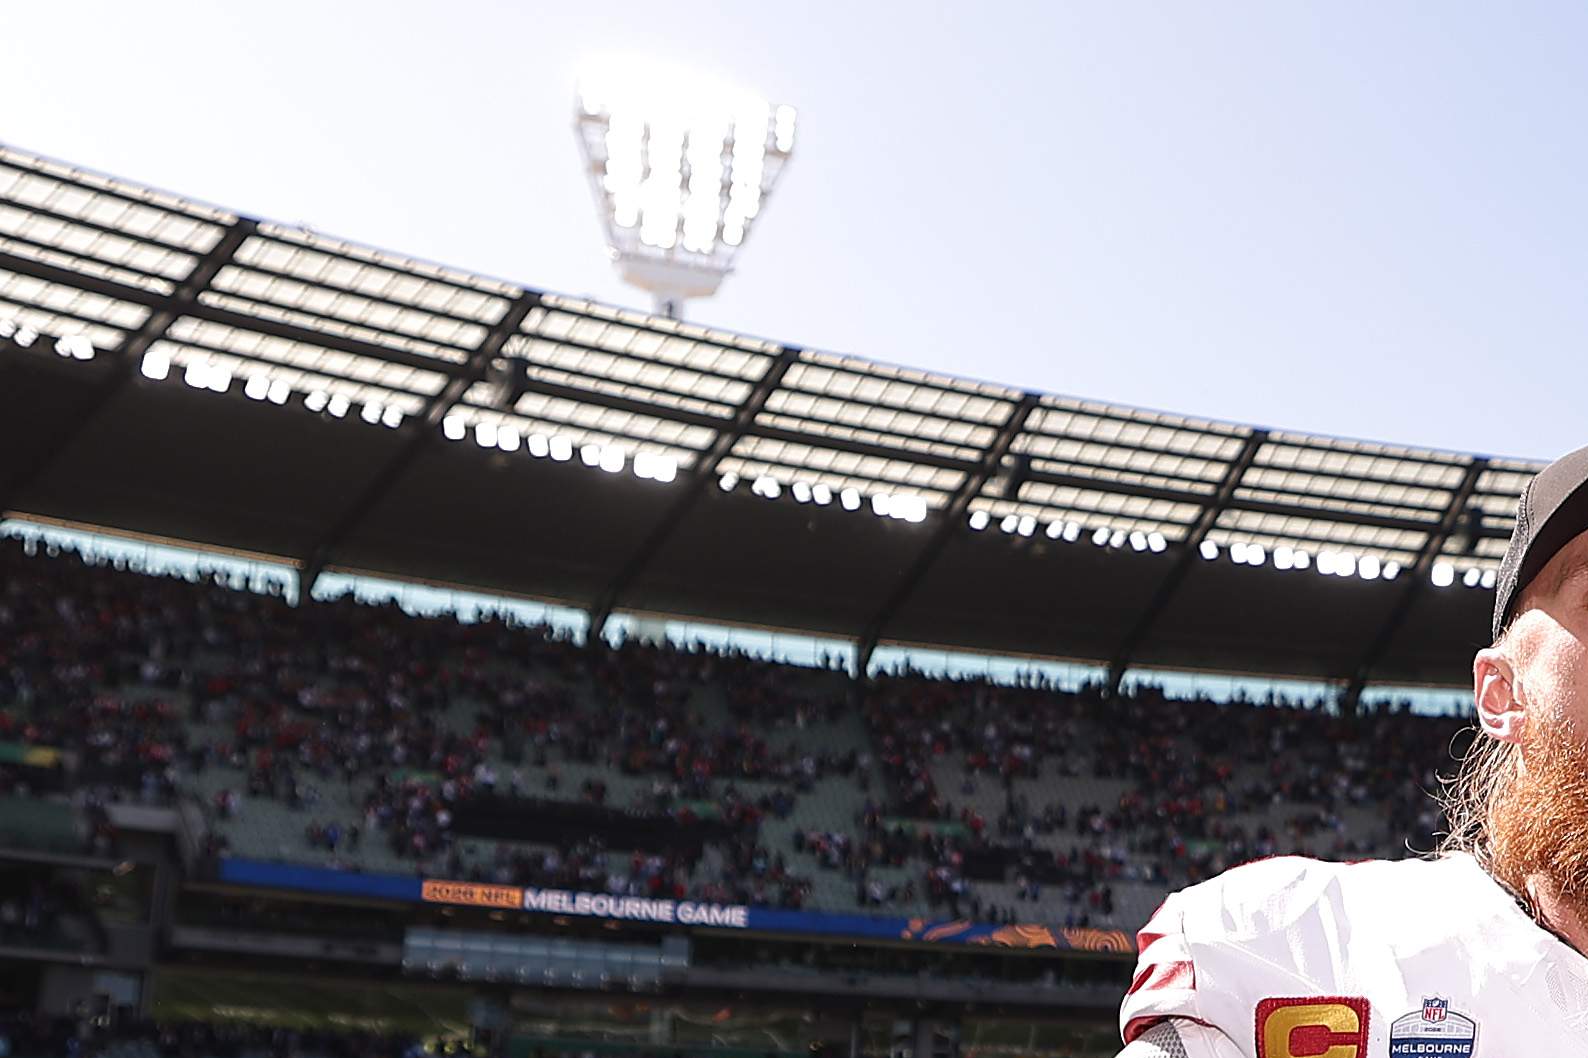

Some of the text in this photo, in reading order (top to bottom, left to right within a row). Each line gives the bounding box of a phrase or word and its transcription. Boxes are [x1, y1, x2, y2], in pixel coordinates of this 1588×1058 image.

[524, 887, 674, 922] MELBOURNE
[677, 901, 748, 928] GAME
[1425, 1008, 1445, 1020] NFL
[1391, 1044, 1471, 1053] MELBOURNE
